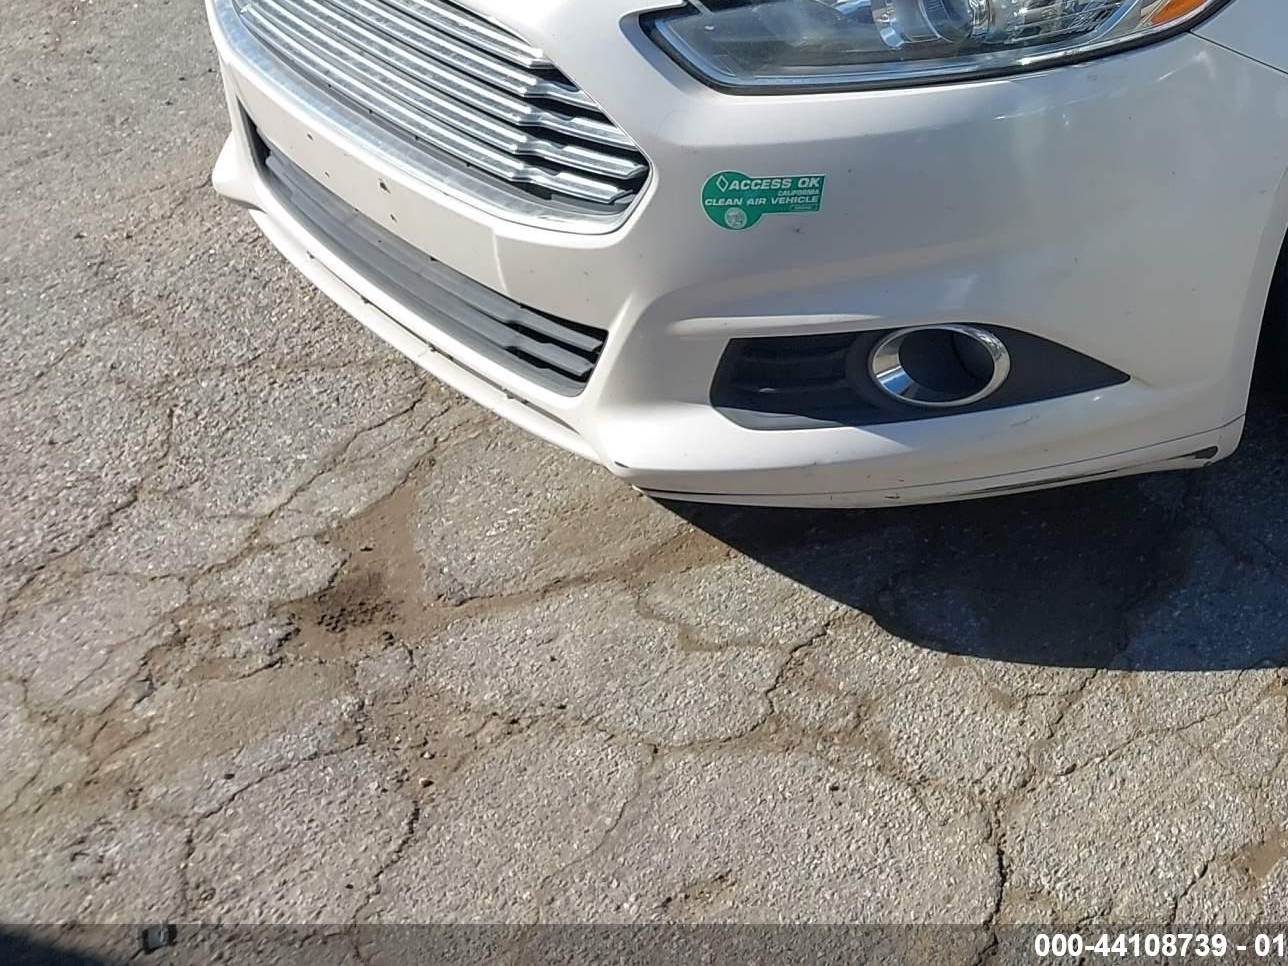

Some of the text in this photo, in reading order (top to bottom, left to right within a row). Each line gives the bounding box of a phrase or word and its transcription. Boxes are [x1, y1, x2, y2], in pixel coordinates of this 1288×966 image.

[728, 177, 820, 190] ACCESS OK
[705, 195, 818, 206] CLEAN AIR VEHICLE
